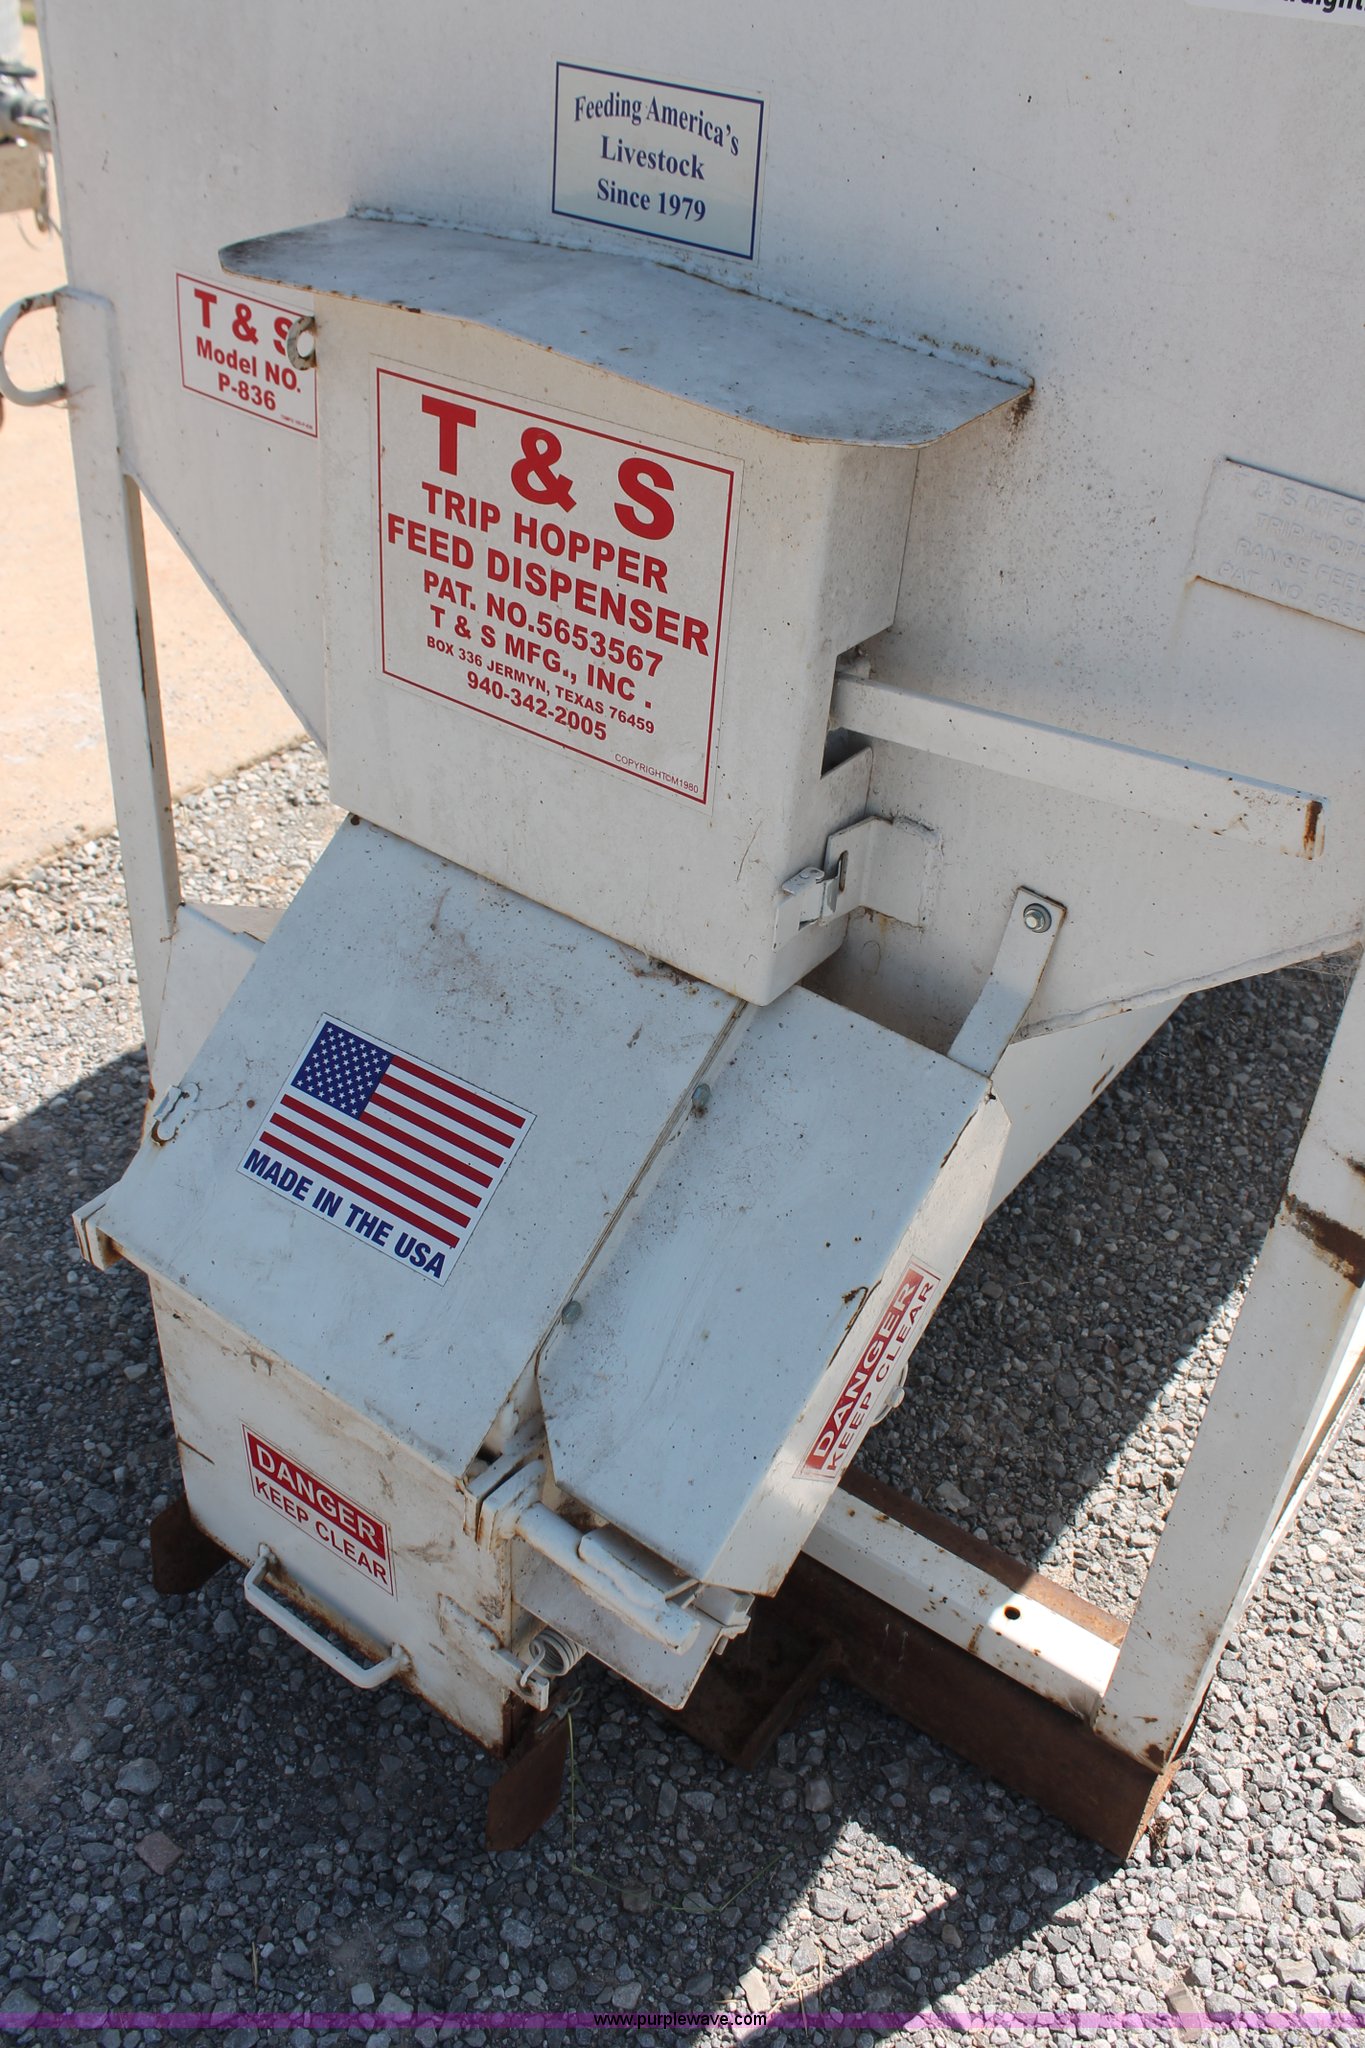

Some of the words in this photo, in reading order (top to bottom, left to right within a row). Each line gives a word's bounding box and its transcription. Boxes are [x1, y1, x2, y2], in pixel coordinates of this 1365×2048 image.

[574, 92, 642, 126] Feeding
[646, 96, 739, 156] America's
[601, 135, 705, 180] Livestock
[597, 178, 650, 210] Since
[658, 192, 706, 222] 1979
[194, 288, 217, 329] T
[231, 303, 259, 345] &
[196, 335, 257, 377] Model
[265, 360, 301, 393] NO.
[218, 372, 276, 411] P-836
[422, 394, 477, 476] T
[511, 427, 577, 513] &
[614, 457, 675, 541] S
[387, 513, 474, 570] FEED
[487, 547, 710, 657] DISPENSER
[421, 481, 501, 533] TRIP
[514, 512, 668, 594] HOPPER
[423, 569, 476, 611] PAT.
[486, 592, 663, 677] NO.5653567
[430, 604, 446, 628] T
[454, 615, 472, 639] &
[481, 624, 496, 648] S
[505, 632, 577, 685] MFG.,
[427, 635, 454, 656] BOX
[459, 648, 482, 667] 336
[487, 660, 550, 696] JERMYN,
[555, 685, 604, 715] TEXAS
[609, 706, 655, 734] 76459
[467, 670, 607, 741] 940-342-2005
[243, 1148, 313, 1201] MADE
[312, 1186, 344, 1218] IN
[345, 1203, 394, 1247] THE
[394, 1232, 446, 1279] USA
[813, 1283, 916, 1458] DANGER
[826, 1391, 872, 1471] KEEP
[876, 1281, 934, 1383] CLEAR
[255, 1476, 309, 1523] KEEP
[315, 1521, 388, 1585] CLEAR
[256, 1444, 378, 1549] DANGER
